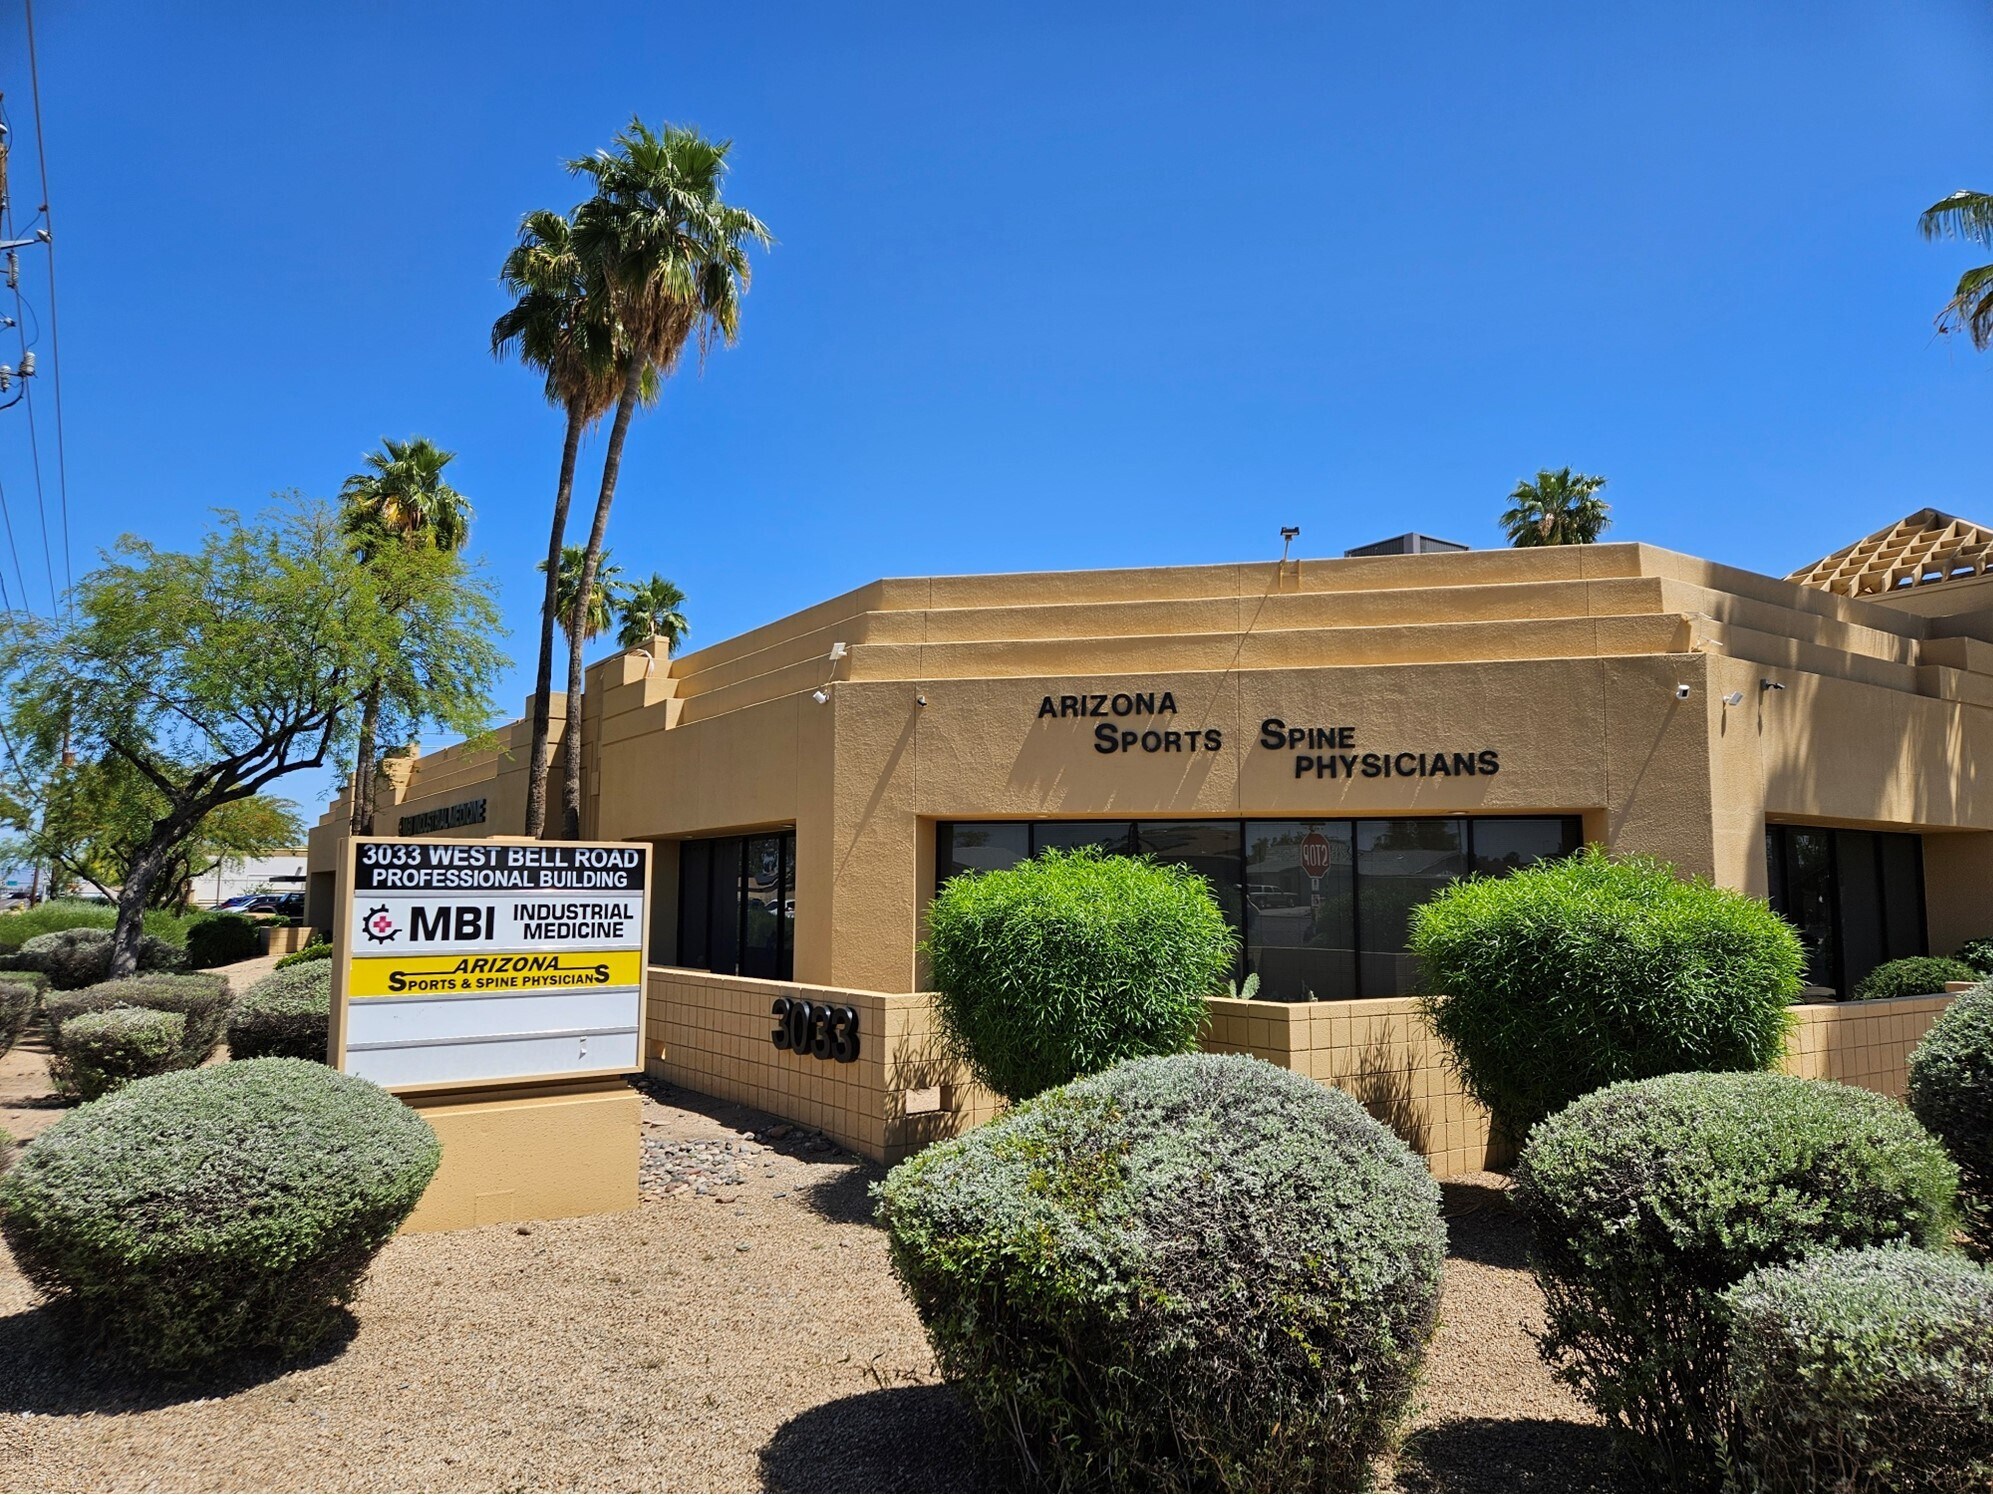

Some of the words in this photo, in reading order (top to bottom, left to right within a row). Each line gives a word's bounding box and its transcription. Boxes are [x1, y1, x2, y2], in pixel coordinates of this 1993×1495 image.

[1038, 692, 1177, 718] ARIZONA
[1094, 723, 1222, 754] SPORTS
[1260, 718, 1355, 750] SPINE
[1295, 751, 1500, 779] PHYSICIANS
[450, 799, 487, 829] MEDICINE
[362, 844, 421, 866] 3033
[428, 845, 501, 867] WEST
[507, 846, 569, 867] BELL
[574, 848, 639, 868] ROAD
[372, 868, 535, 887] PROFESSIONAL
[540, 870, 628, 888] BUILDING
[409, 905, 495, 941] MBI
[513, 903, 634, 921] INDUSTRIAL
[523, 921, 624, 940] MEDICINE
[387, 970, 457, 992] SPORTS
[461, 978, 472, 989] &
[476, 976, 518, 988] SPINE
[522, 964, 610, 987] PHYSICIANS
[454, 955, 559, 974] ARIZONA
[771, 998, 860, 1063] 3033
